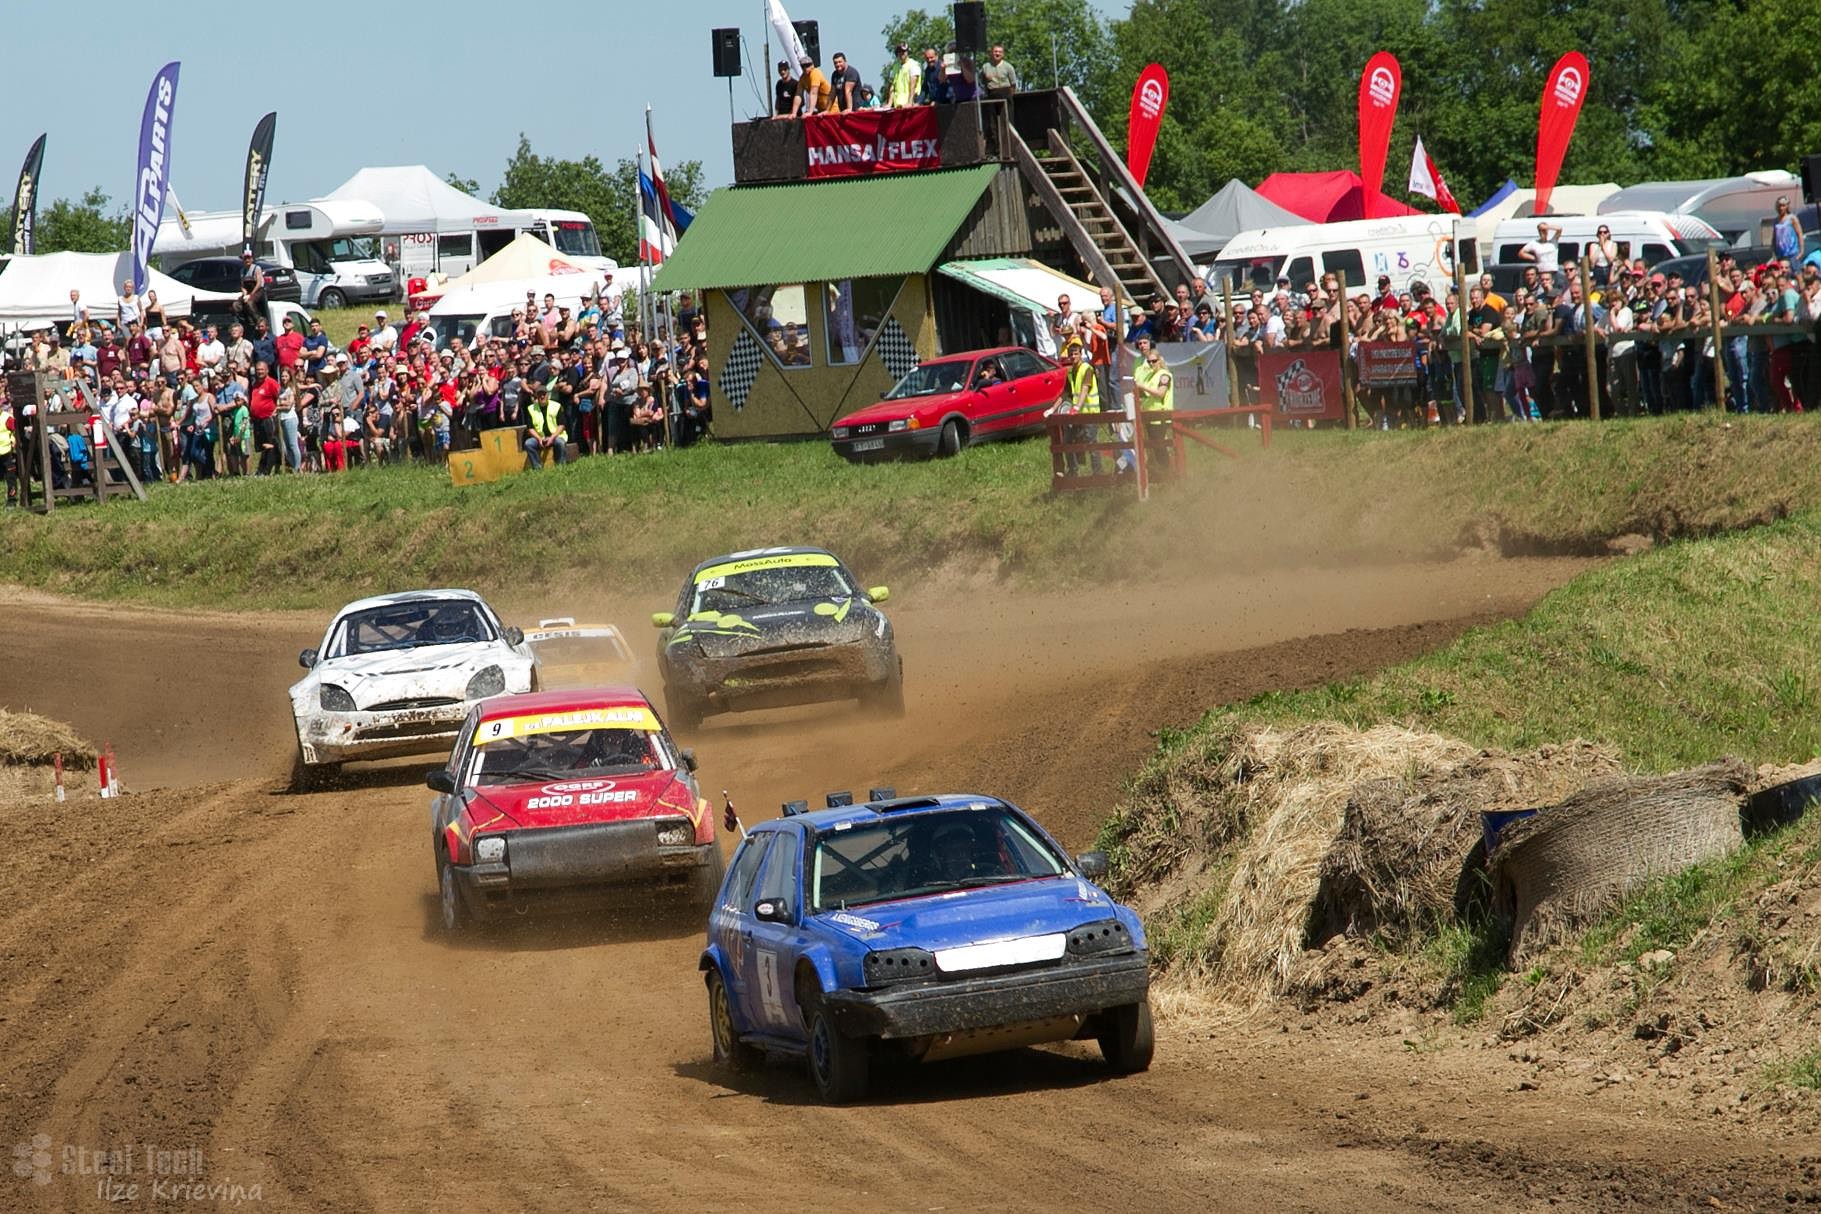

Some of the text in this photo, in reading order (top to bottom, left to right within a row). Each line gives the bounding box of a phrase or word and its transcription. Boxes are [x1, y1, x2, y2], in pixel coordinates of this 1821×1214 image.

[244, 149, 262, 239] BATTERY
[494, 435, 502, 453] 1
[463, 459, 474, 479] 2
[703, 579, 719, 591] 76
[491, 723, 502, 737] 9
[527, 790, 638, 810] 2000 SUPER
[764, 955, 774, 998] 3
